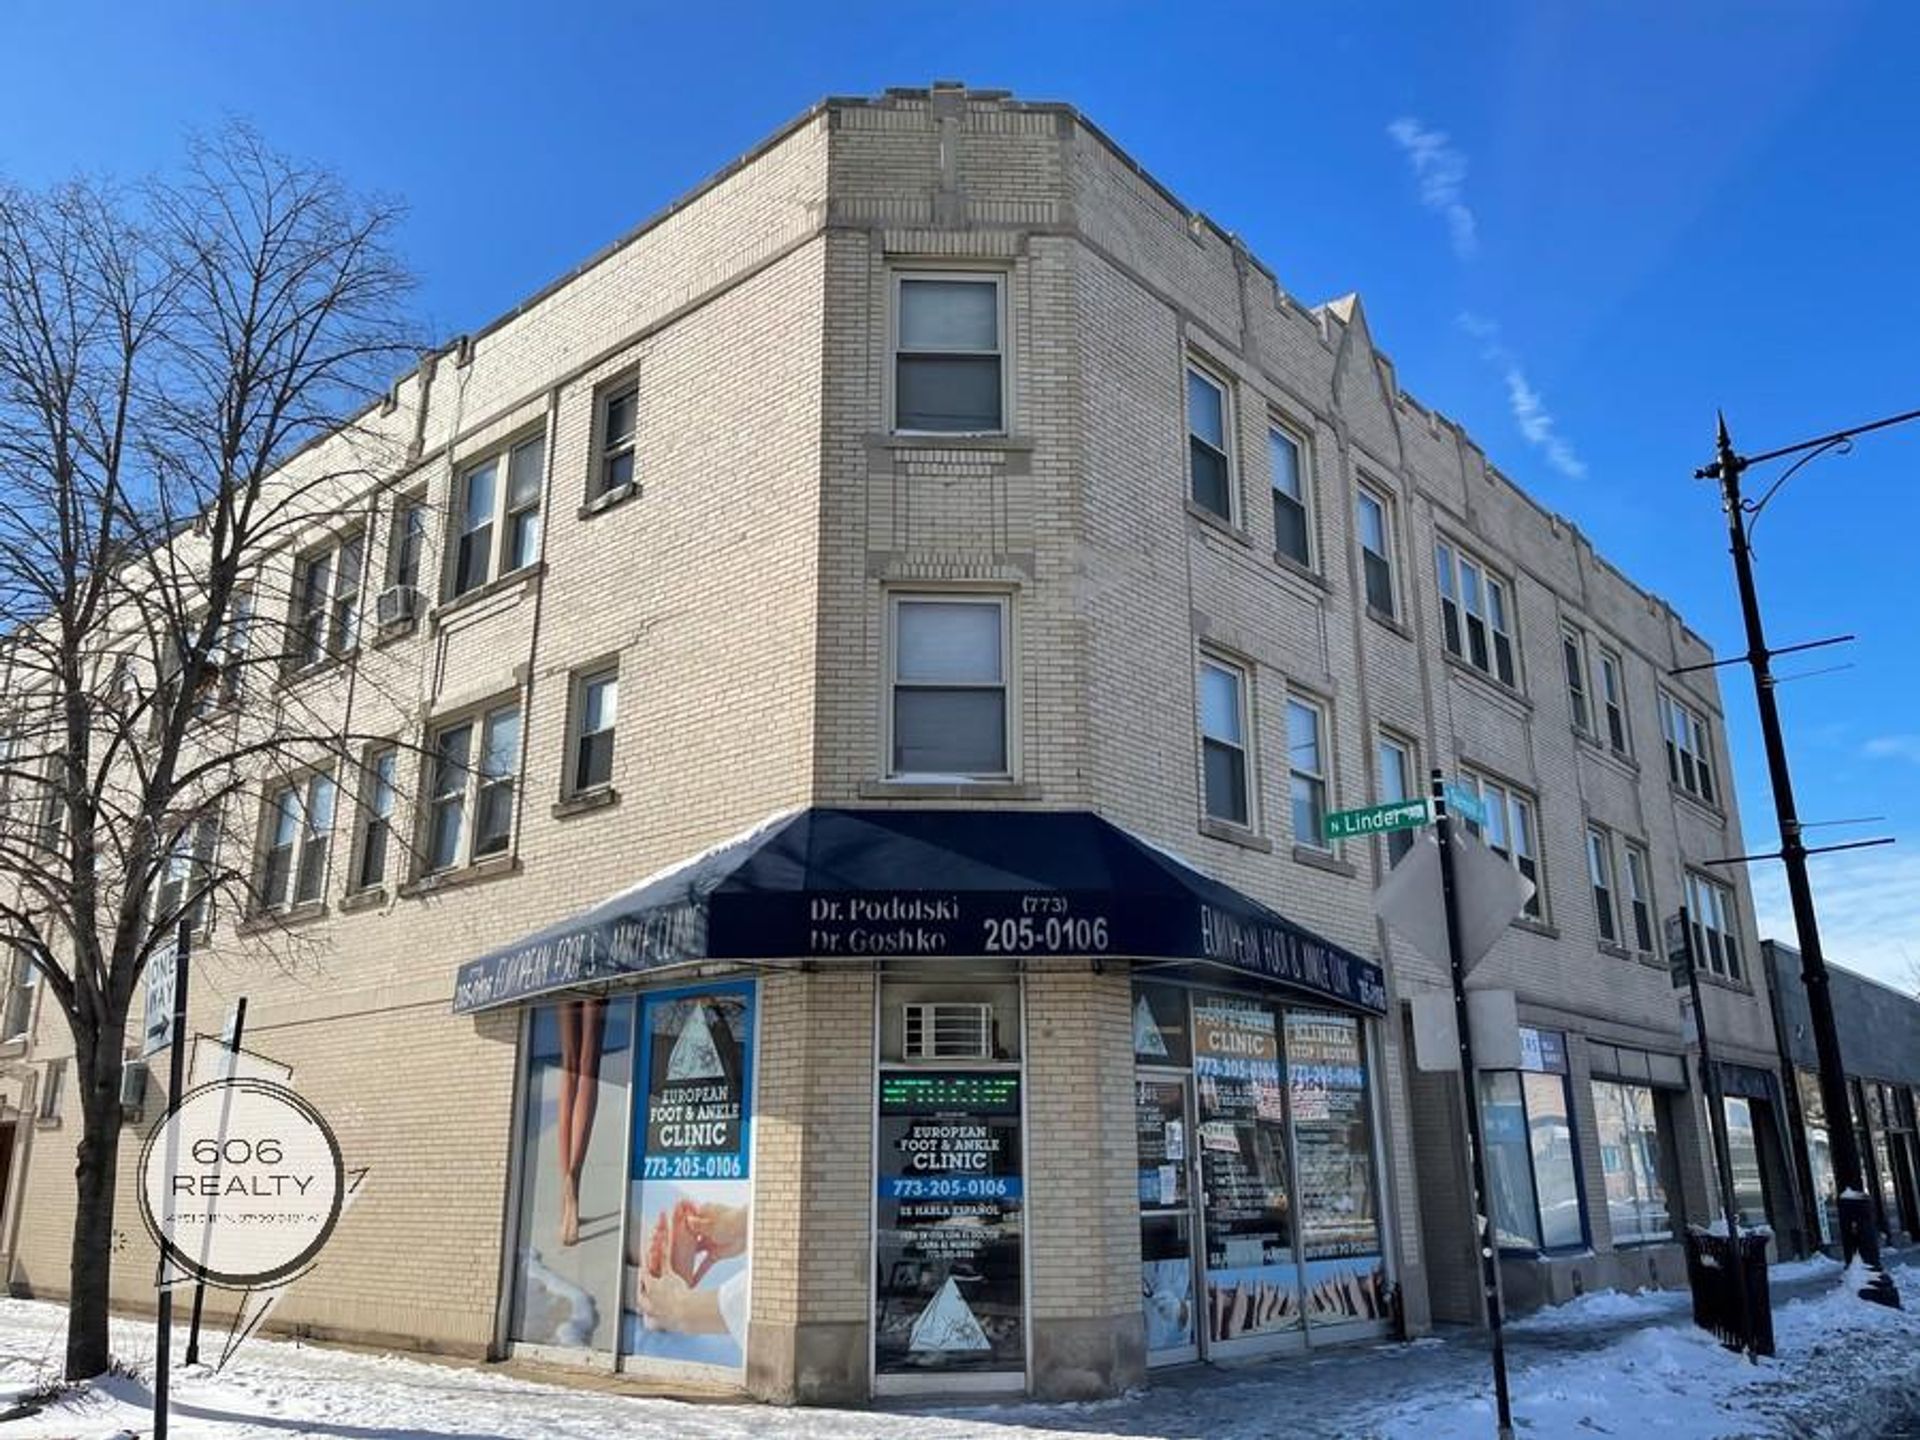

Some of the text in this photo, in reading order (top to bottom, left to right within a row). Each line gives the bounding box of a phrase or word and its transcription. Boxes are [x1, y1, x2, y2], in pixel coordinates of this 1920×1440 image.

[1331, 821, 1339, 832] N
[1345, 808, 1400, 832] Linder
[810, 896, 959, 921] Dr. Podolski
[1022, 896, 1068, 914] (773)
[810, 928, 946, 951] Dr. Goshko
[983, 917, 1109, 951] 205-0106
[147, 949, 177, 986] ONE
[148, 979, 175, 1016] WAY
[1209, 1031, 1264, 1054] CLINIC
[661, 1086, 729, 1104] EUROPEAN
[650, 1103, 739, 1123] FOOT & ANKLE
[660, 1122, 726, 1147] CLINIC
[913, 1126, 987, 1138] EUROPEAN
[900, 1139, 1000, 1151] FOOT & ANKLE
[644, 1156, 741, 1177] 773-205-0106
[913, 1152, 987, 1170] CLINIC
[893, 1179, 1007, 1196] 773-205-0106
